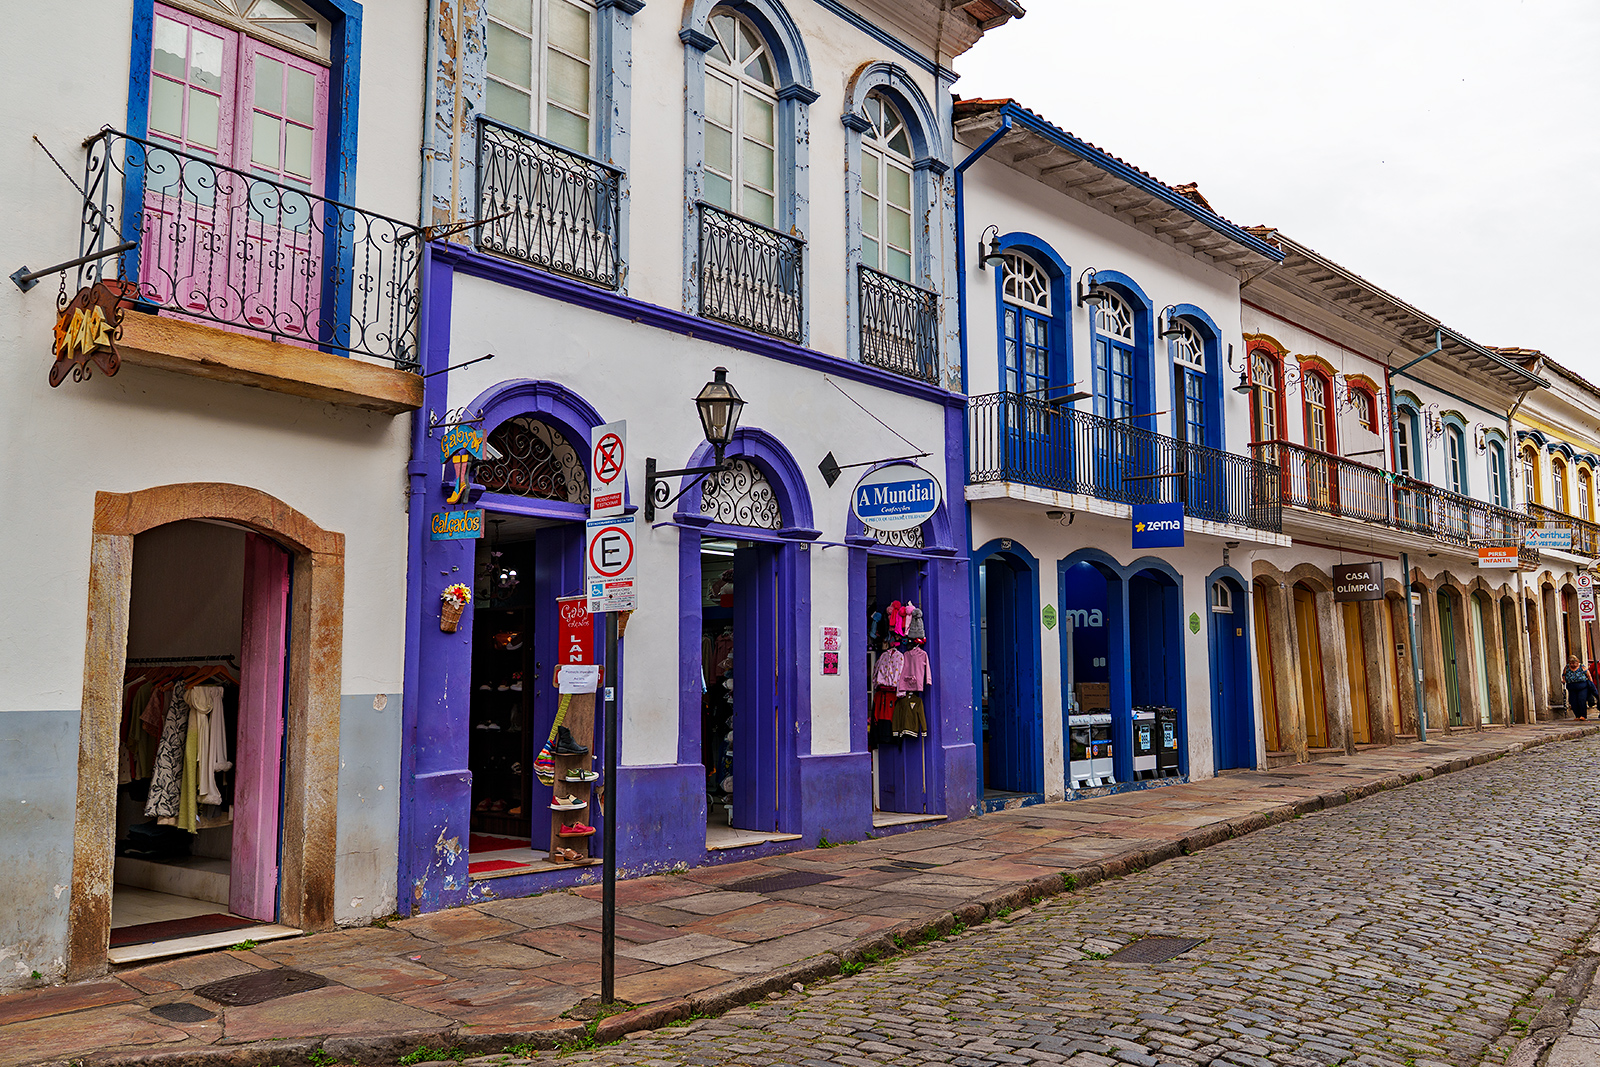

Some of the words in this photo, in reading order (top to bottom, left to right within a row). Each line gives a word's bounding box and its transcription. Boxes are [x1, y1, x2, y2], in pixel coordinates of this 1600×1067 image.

[441, 425, 473, 459] Gaby
[859, 488, 870, 507] A
[873, 482, 934, 506] Mundial
[431, 512, 480, 536] Calçados
[1147, 520, 1181, 531] zema
[601, 535, 622, 567] E
[1337, 583, 1380, 593] OLÍMPICA
[1345, 572, 1370, 581] CASA
